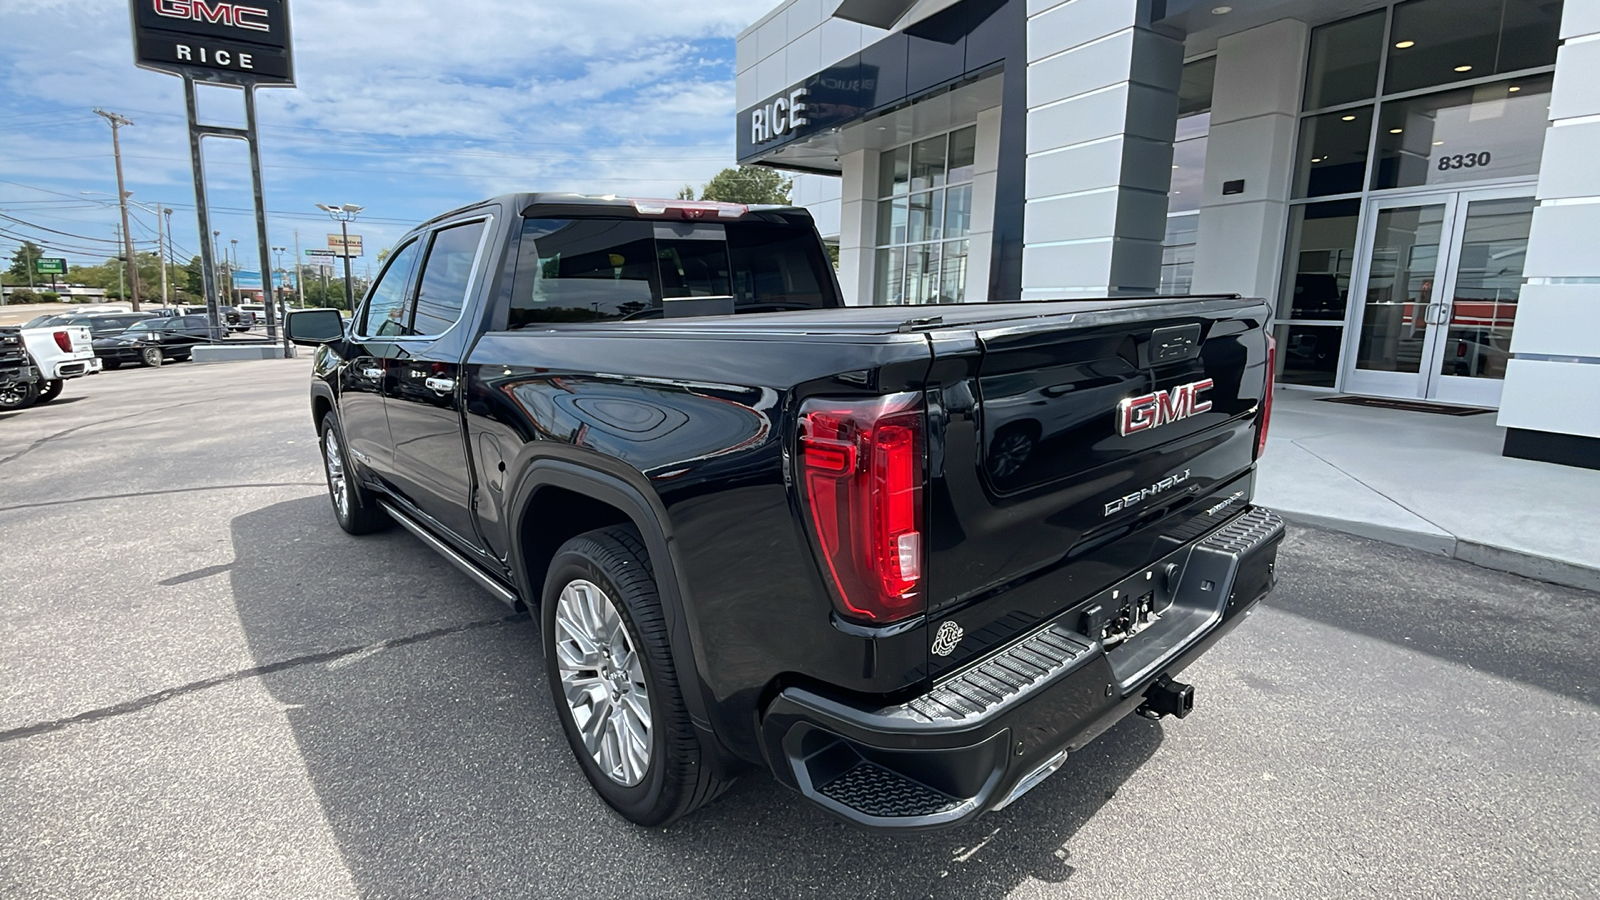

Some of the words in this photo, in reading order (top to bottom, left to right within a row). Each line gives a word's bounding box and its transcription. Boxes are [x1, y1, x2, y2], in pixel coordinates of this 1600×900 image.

[153, 0, 270, 32] GMC
[176, 44, 254, 69] RICE
[751, 87, 807, 145] RICE
[1438, 151, 1491, 171] 8330
[1116, 378, 1214, 437] GMC
[1104, 469, 1190, 517] DENALI
